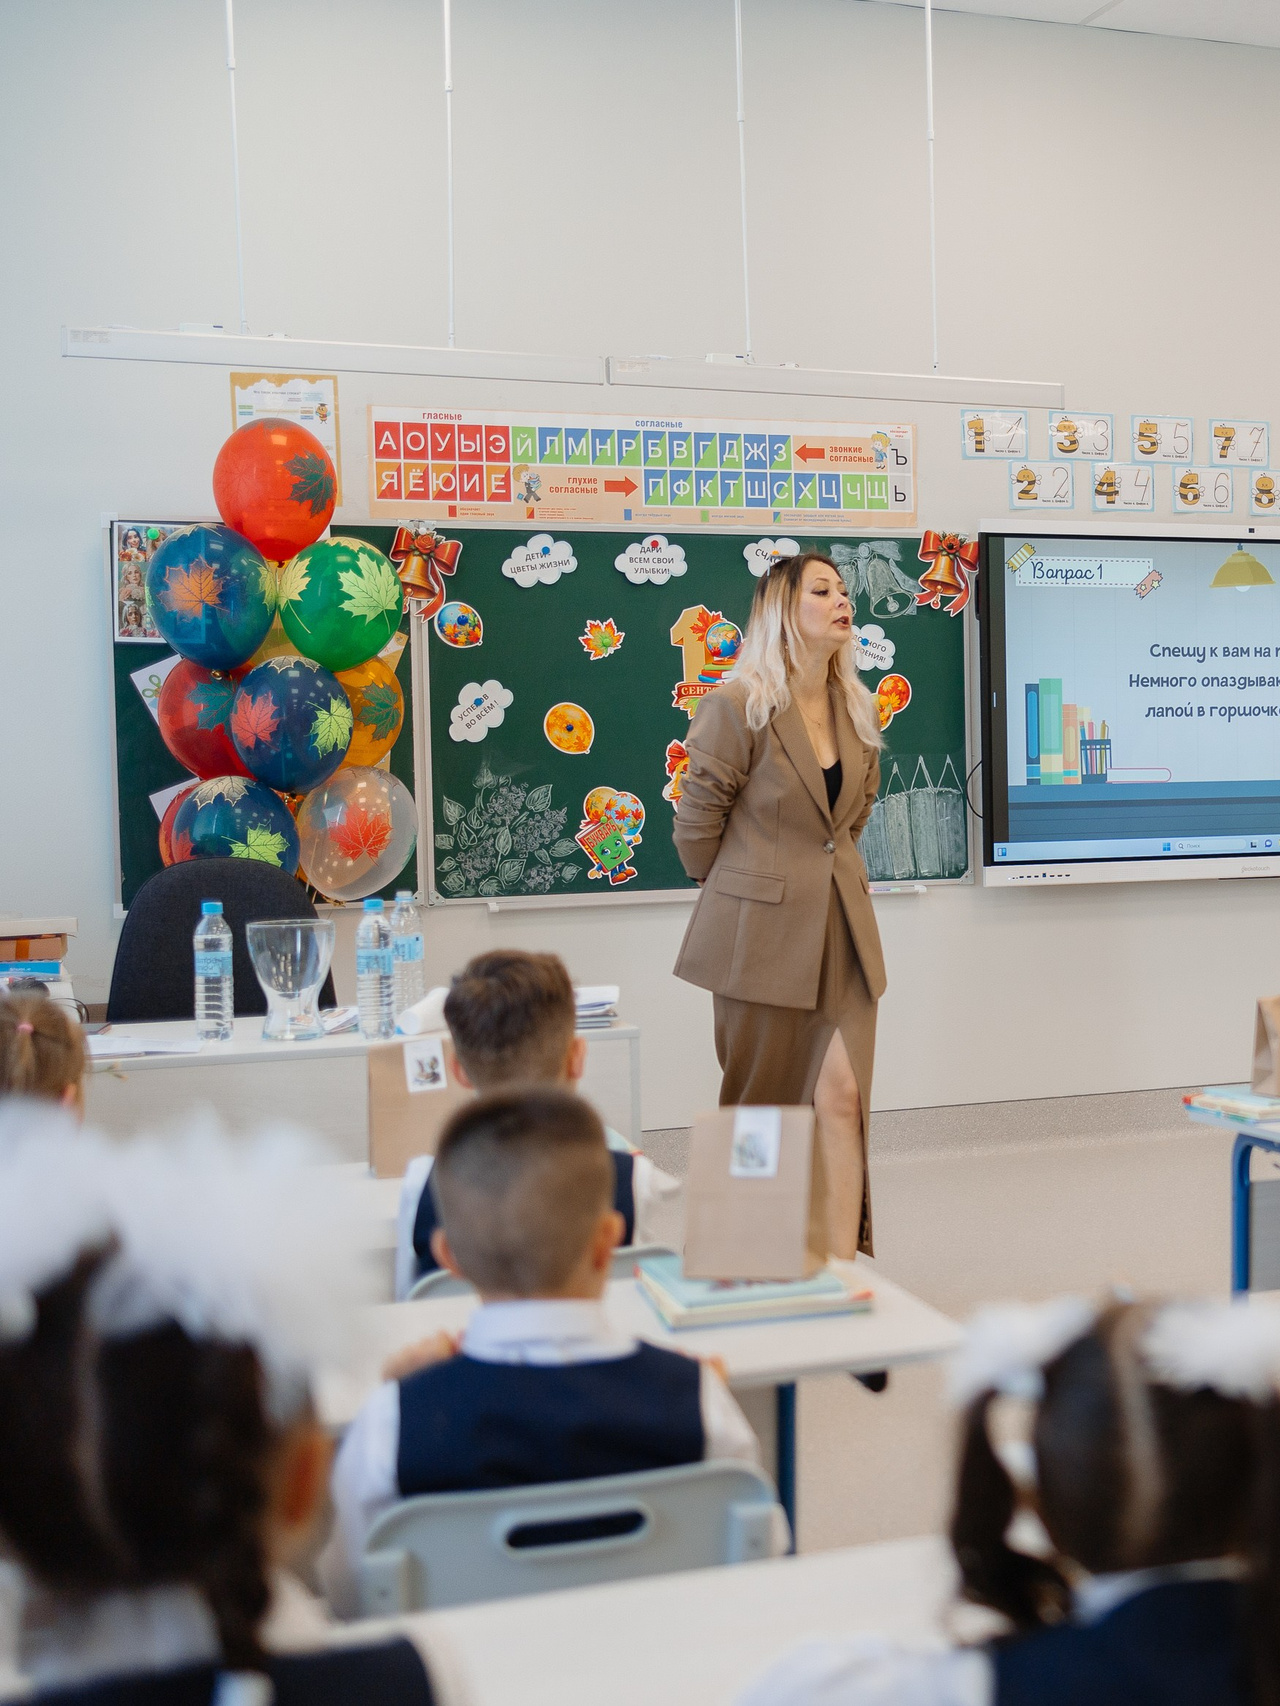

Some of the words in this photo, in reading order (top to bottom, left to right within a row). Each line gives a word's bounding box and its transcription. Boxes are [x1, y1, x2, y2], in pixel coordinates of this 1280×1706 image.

[422, 410, 463, 422] гласные
[635, 418, 684, 430] согласные
[379, 431, 398, 451] А
[406, 431, 425, 452] О
[431, 433, 451, 452] У
[460, 434, 481, 453] Ы
[488, 434, 506, 454] Э
[517, 433, 532, 456] Й
[544, 436, 560, 455] Л
[568, 437, 587, 456] М
[596, 438, 611, 457] Н
[622, 439, 636, 457] Р
[648, 440, 663, 459] Б
[673, 440, 688, 459] В
[699, 441, 712, 459] Г
[722, 442, 739, 463] Д
[744, 443, 766, 461] Ж
[773, 443, 786, 462] З
[967, 418, 985, 453] 1
[1056, 420, 1080, 454] 3
[1138, 422, 1159, 455] 5
[1214, 427, 1236, 459] 7
[829, 445, 862, 454] звонкие
[829, 453, 874, 463] согласные
[891, 448, 908, 466] Ъ
[381, 471, 398, 491] Я
[409, 468, 424, 491] Ё
[432, 472, 457, 492] Ю
[464, 473, 480, 493] И
[492, 474, 506, 493] Е
[549, 485, 599, 495] согласные
[567, 476, 598, 486] глухие
[649, 478, 664, 497] П
[673, 479, 690, 497] Ф
[700, 480, 713, 498] К
[725, 480, 739, 499] Т
[747, 481, 766, 499] Ш
[773, 481, 789, 500] С
[798, 481, 813, 500] Х
[822, 481, 838, 504] Ц
[847, 481, 861, 501] Ч
[867, 481, 887, 504] Щ
[894, 485, 907, 502] Ь
[1016, 468, 1039, 500] 2
[1094, 470, 1120, 505] 4
[1179, 473, 1201, 506] 6
[1255, 476, 1275, 509] 8
[524, 551, 546, 562] ДЕТИ
[640, 546, 662, 554] ДАРИ
[509, 563, 538, 575] ЦВЕТЫ
[538, 559, 571, 570] ЖИЗНИ
[1030, 561, 1095, 585] Вопрос
[1097, 563, 1102, 580] 1
[1149, 643, 1207, 664] Спешу
[1210, 646, 1218, 659] к
[1222, 645, 1251, 659] вам
[1254, 645, 1272, 659] на
[681, 687, 720, 695] СЕНТ
[1128, 673, 1197, 689] Немного
[457, 693, 489, 722] УСПЕВ
[465, 718, 477, 730] ВО
[475, 703, 496, 721] ВСЁМ
[1197, 704, 1205, 717] в
[585, 821, 617, 849] БУКВАРЬ
